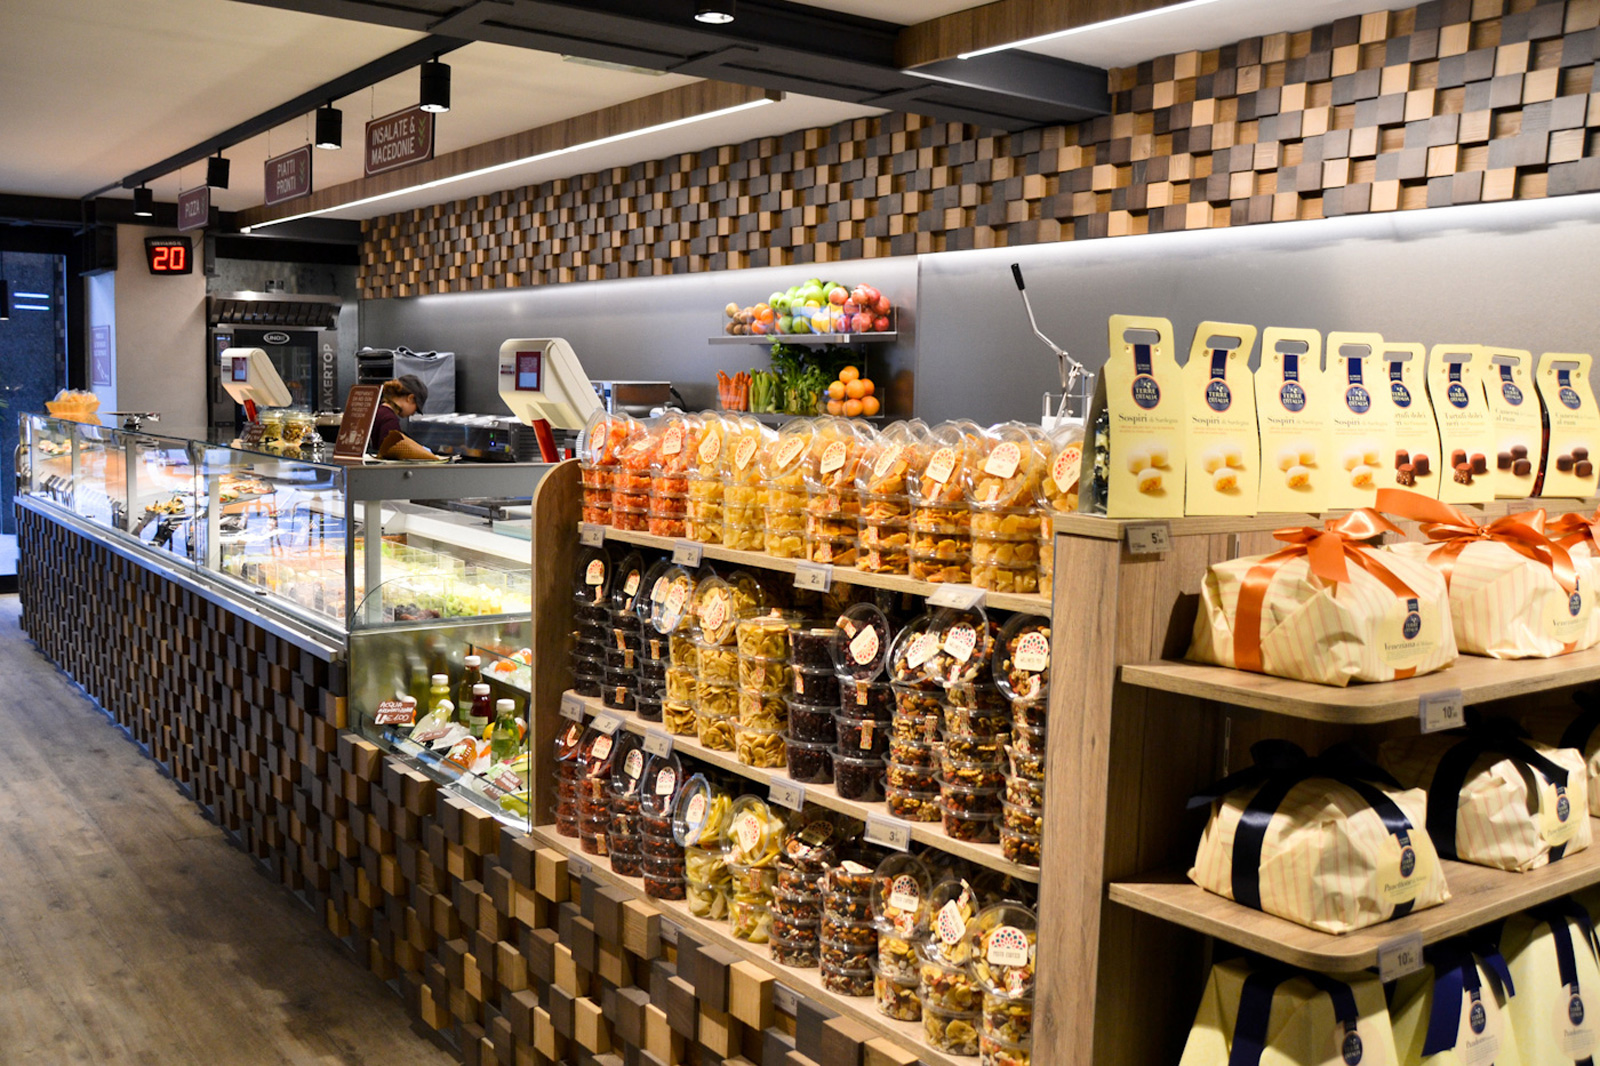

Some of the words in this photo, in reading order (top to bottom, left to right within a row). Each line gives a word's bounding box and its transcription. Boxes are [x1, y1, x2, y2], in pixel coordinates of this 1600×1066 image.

[372, 118, 408, 146] INSALATE
[409, 116, 415, 134] &
[371, 136, 415, 165] MACEDONIE
[277, 158, 296, 179] PIATTI
[276, 176, 296, 195] PRONTI
[185, 199, 200, 219] PIZZA
[153, 246, 186, 270] 20
[1119, 413, 1147, 425] Sospiri
[1192, 416, 1220, 427] Sospiri
[1267, 416, 1295, 426] Sospiri
[1334, 418, 1360, 428] Sospiri
[1385, 642, 1416, 650] Veneziana
[889, 831, 895, 841] 3
